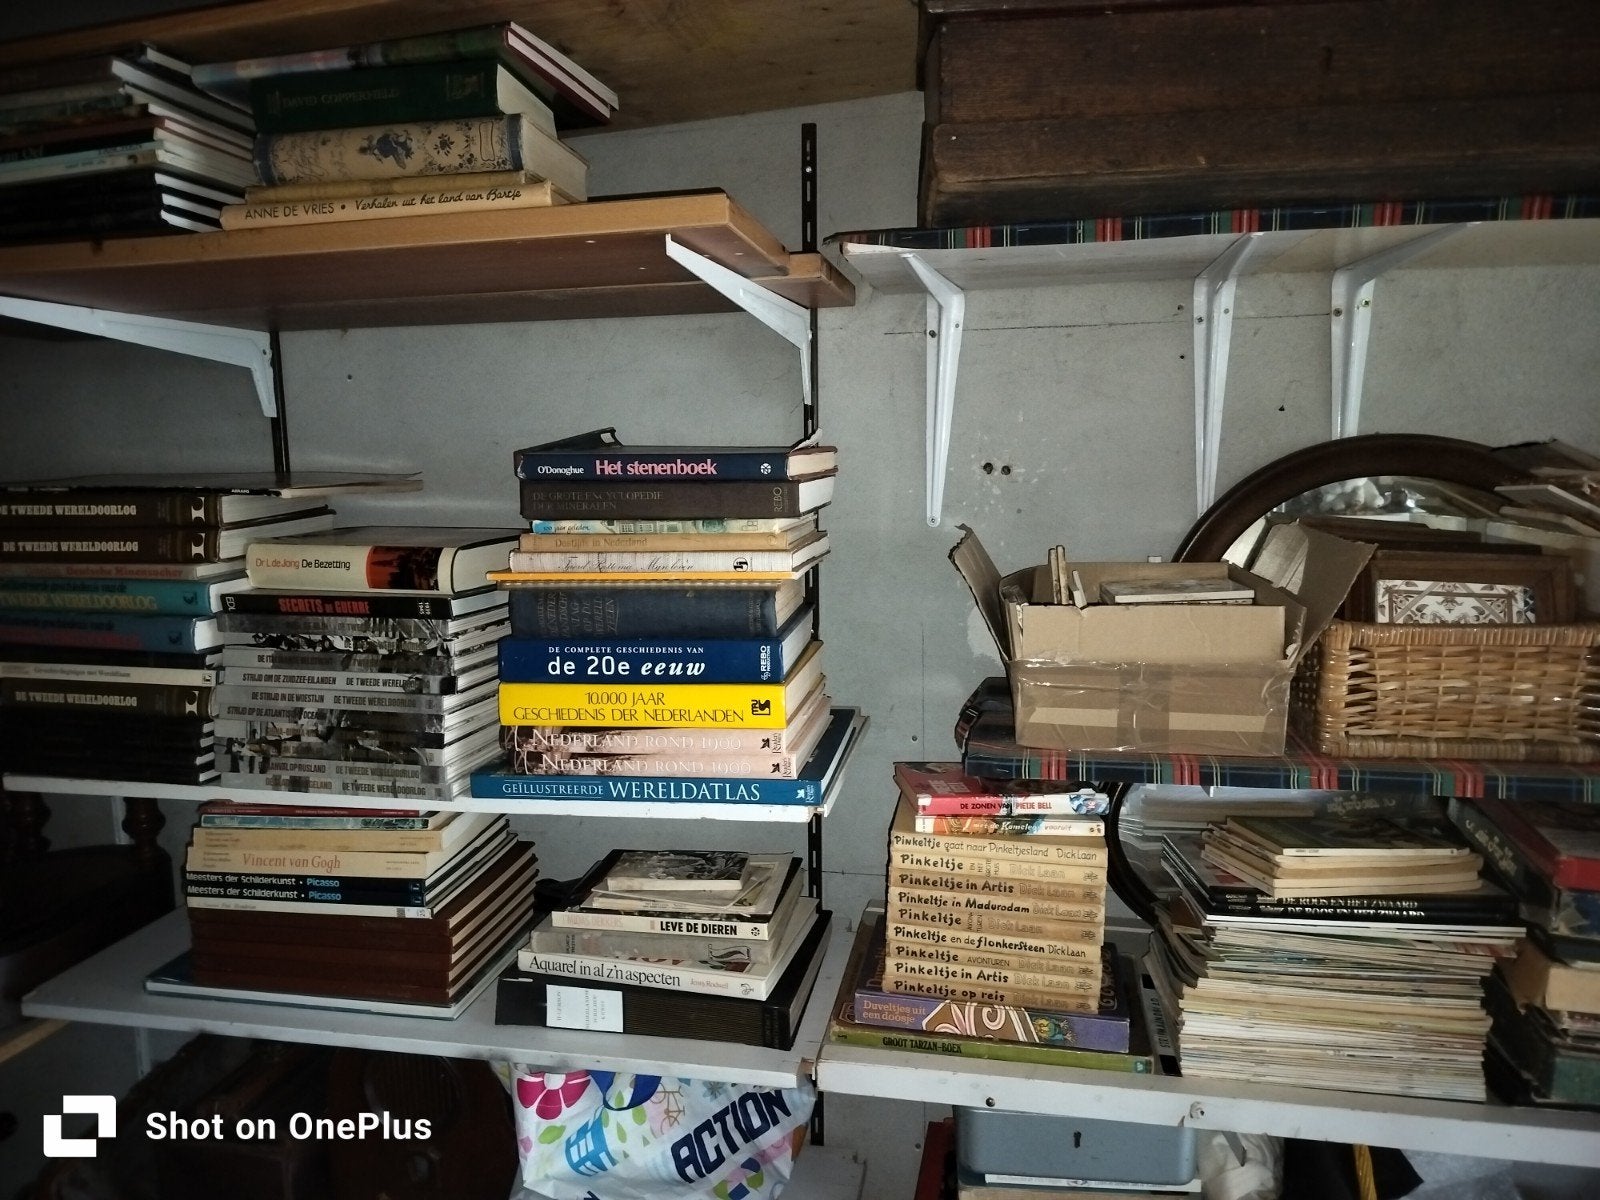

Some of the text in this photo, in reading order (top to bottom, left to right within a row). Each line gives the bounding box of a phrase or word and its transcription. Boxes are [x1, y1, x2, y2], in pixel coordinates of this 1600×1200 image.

[245, 206, 279, 220] ANNE
[284, 205, 298, 218] DE
[303, 202, 334, 216] VRIES
[355, 198, 398, 211] Verhalen
[402, 197, 416, 206] uit
[420, 194, 436, 206] het
[438, 191, 464, 204] land
[466, 192, 484, 202] van
[537, 458, 718, 476] O'Donoghue Het stenenboek
[533, 492, 546, 500] DE
[549, 492, 584, 500] GROTE
[773, 487, 782, 512] REBO
[11, 505, 136, 516] TWEEDE WERELDOORLOG
[559, 502, 617, 511] MINERALEN
[3, 542, 139, 552] DE TWEEDE WERELDOORLOG
[604, 538, 648, 547] Nederland
[302, 559, 313, 568] De
[314, 560, 351, 571] Bezetting
[279, 598, 370, 614] SECRETS GUERRE
[548, 646, 561, 654] DE
[564, 646, 612, 654] COMPLETE
[616, 646, 684, 654] GESCHIEDENIS
[548, 656, 706, 676] de 20e eeuw
[242, 673, 263, 682] STRIJD
[274, 674, 282, 682] DE
[346, 677, 354, 686] DE
[356, 678, 380, 686] TWEEDE
[14, 691, 138, 706] DE TWEEDE WERELDOORLOG
[252, 692, 416, 708] DE STRIJD IN DE WOESTIJN DE TWEEDE WERELDOORLOG
[585, 692, 665, 706] 10.000 JAAR
[227, 706, 248, 716] STRIJD
[514, 707, 744, 722] GESCHIEDENIS DER NEDERLANDEN
[532, 728, 638, 749] NEDERLAND
[646, 735, 694, 748] ROND
[542, 752, 648, 772] NEDERLAND
[655, 759, 704, 772] ROND
[298, 764, 326, 774] RUSLAND
[336, 766, 344, 774] DE
[345, 766, 369, 776] TWEEDE
[370, 768, 420, 778] WERELDOORLOG
[342, 782, 376, 792] DE TWEEDE
[502, 780, 760, 801] GEÏLLUSTREERDE WERELDATLAS
[1038, 802, 1052, 810] BELL
[894, 835, 1097, 860] Pinkeltje gaat naar Pinkeltjesland Dick Laan
[242, 854, 286, 867] Vincent
[288, 858, 309, 868] van
[311, 856, 340, 874] Gogh
[900, 854, 964, 871] Pinkeltje
[1009, 863, 1066, 879] Dick Laan
[186, 873, 340, 887] Meesters der Schilderkunst Picasso
[899, 874, 1076, 898] Pinkeltje in Artis Dick Laan
[188, 886, 342, 900] Meesters der Schilderkunst Picasso
[898, 892, 1030, 914] Pinkeltje in Madurodam
[899, 908, 962, 926] Pinkeltje
[660, 921, 684, 932] LEVE
[686, 922, 699, 934] DE
[702, 923, 738, 936] DIEREN
[894, 926, 1086, 958] Pinkeltje en de Dick Laan
[896, 946, 1010, 967] Pinkeltje AVONTUREN
[530, 956, 576, 975] Aquarel
[580, 960, 591, 976] in
[594, 962, 604, 977] al
[626, 968, 680, 987] aspecten
[894, 962, 1070, 990] Pinkeltje in Artis Dick Laan
[894, 980, 1005, 1002] Pinkeltje op reis
[863, 1000, 926, 1016] Duveltjes uit
[863, 1010, 916, 1024] een doosje
[882, 1036, 962, 1054] GROOT TARZAN-BOEK
[671, 1089, 792, 1184] ACTION
